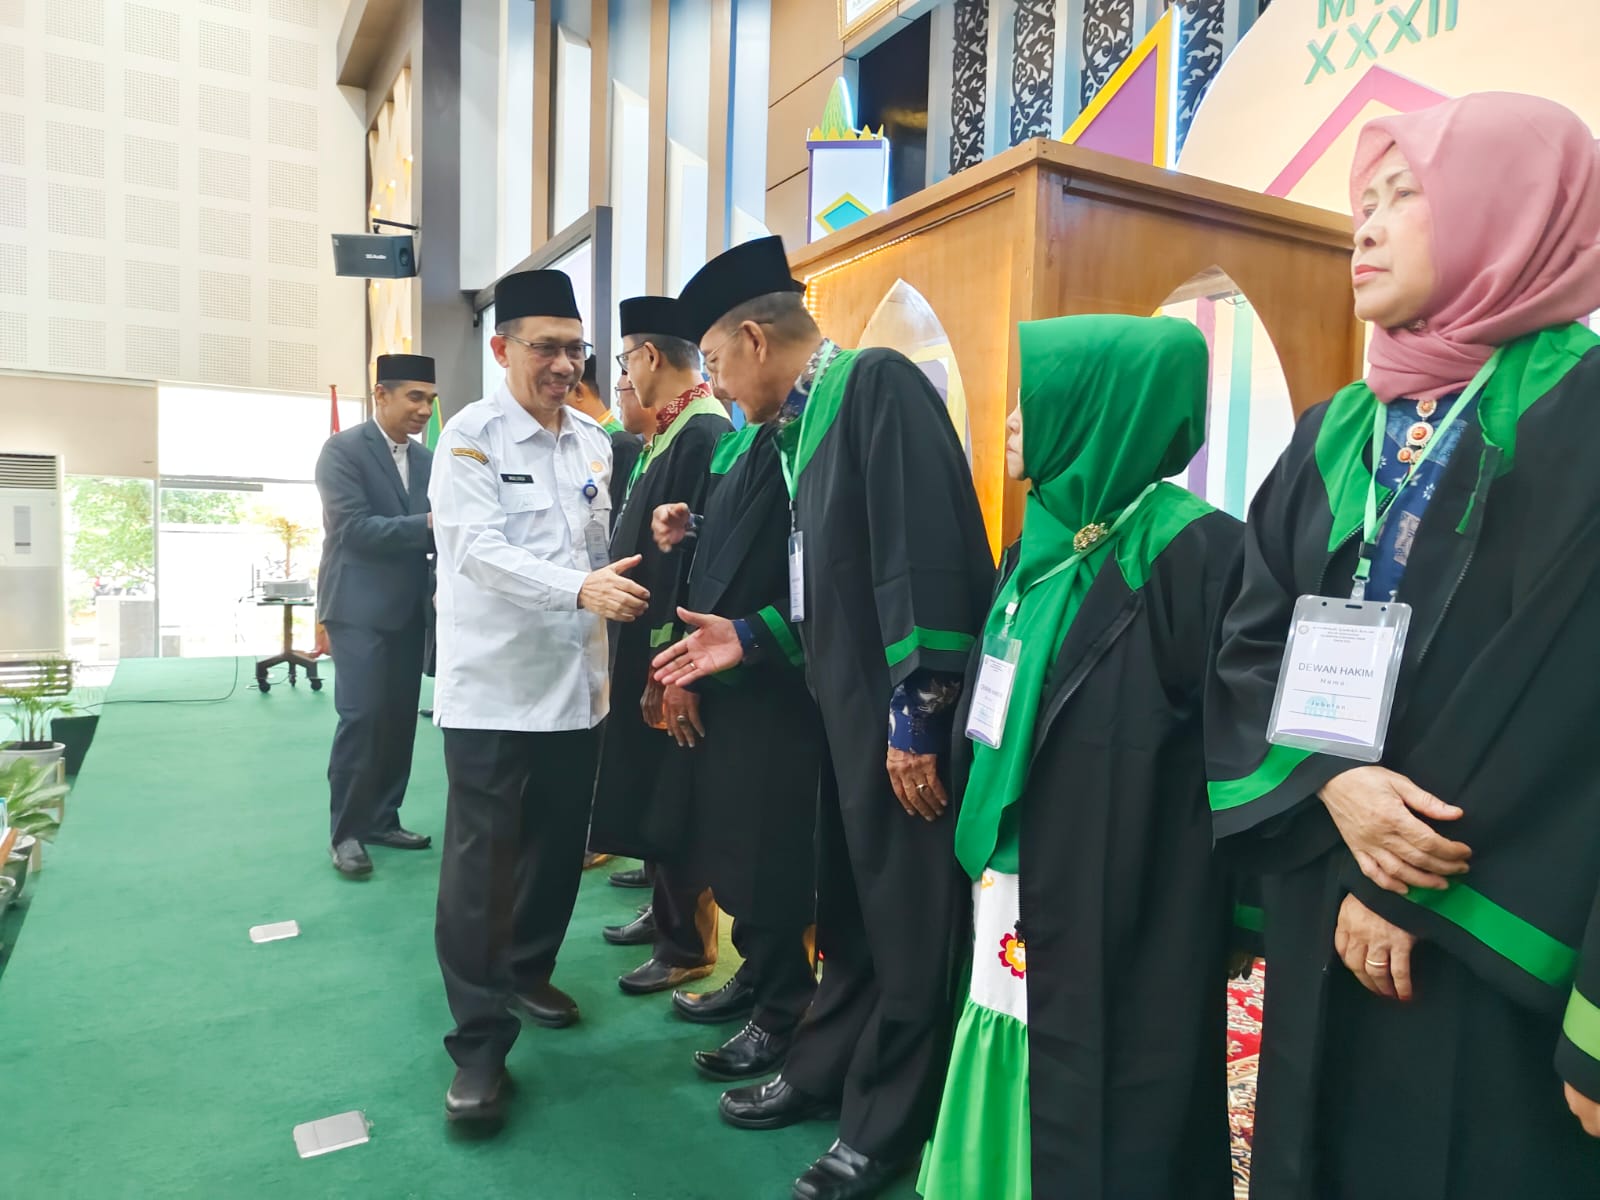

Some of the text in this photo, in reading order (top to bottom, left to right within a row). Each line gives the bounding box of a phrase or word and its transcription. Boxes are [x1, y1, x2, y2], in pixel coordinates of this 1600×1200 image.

[1304, 0, 1459, 85] XXXII
[1298, 662, 1374, 678] DEWAN HAKIM
